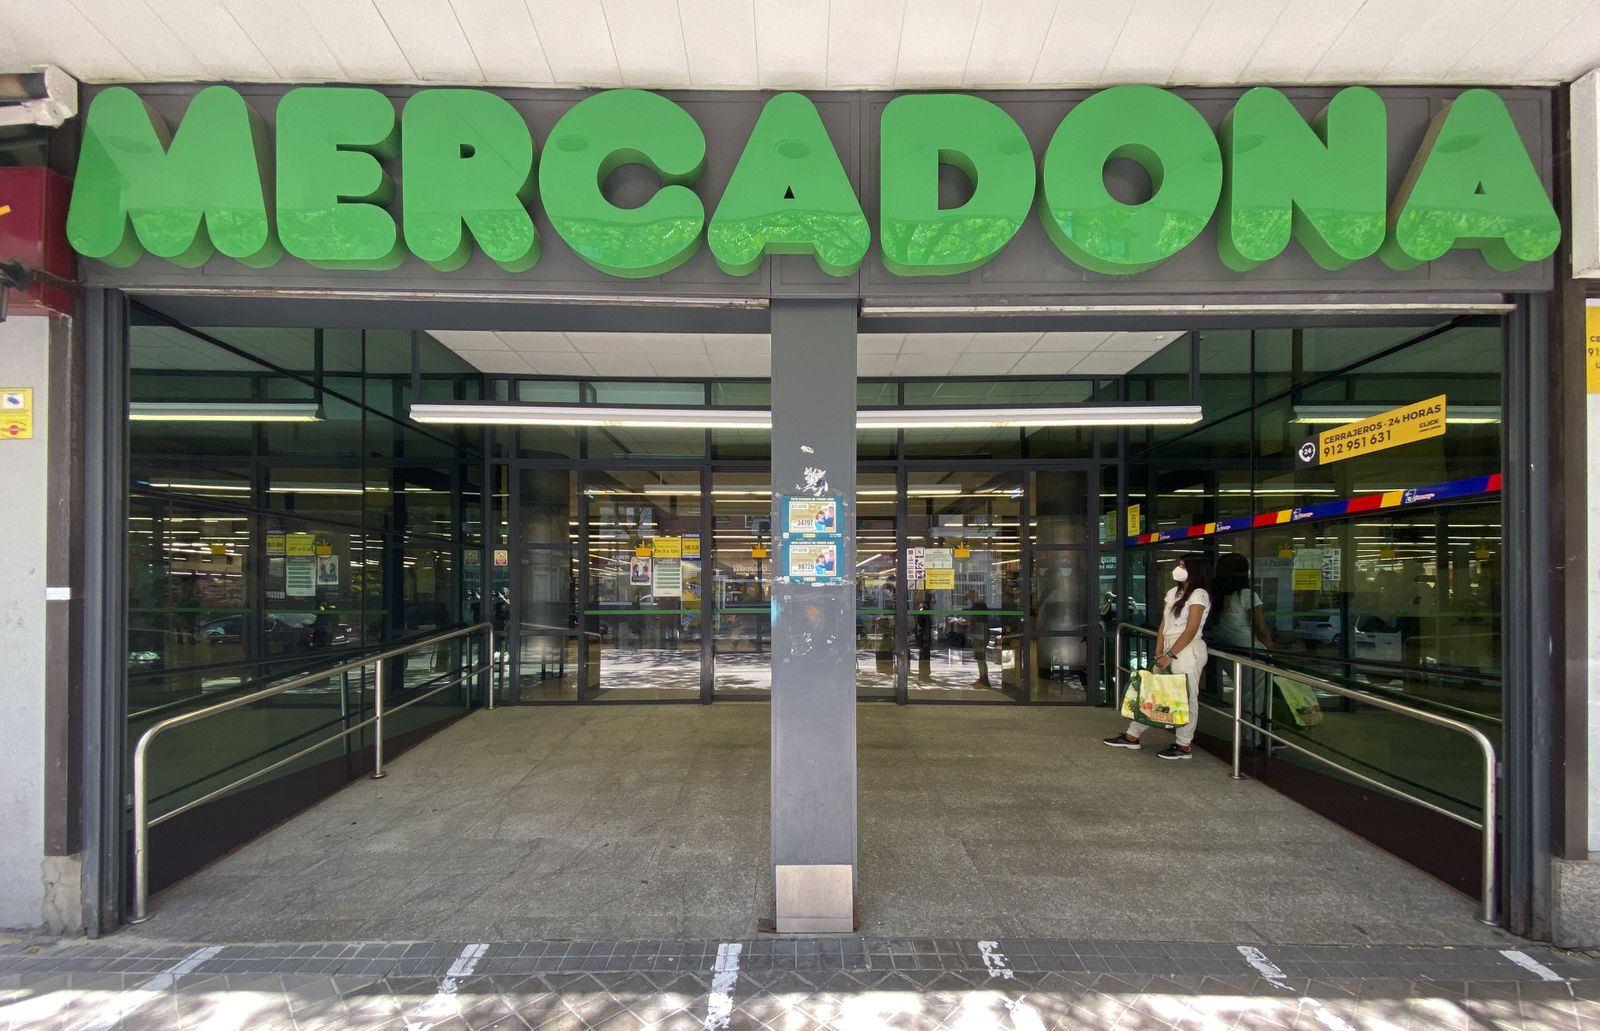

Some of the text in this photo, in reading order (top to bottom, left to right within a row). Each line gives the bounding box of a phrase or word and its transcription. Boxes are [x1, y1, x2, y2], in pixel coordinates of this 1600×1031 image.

[66, 84, 1561, 277] MERCADONA
[1324, 421, 1383, 445] CERRAJEROS
[1388, 417, 1400, 427] 24
[1402, 404, 1442, 422] HORAS
[1419, 418, 1440, 428] CLICK
[1302, 447, 1312, 455] 24
[1323, 430, 1391, 457] 912 951 631
